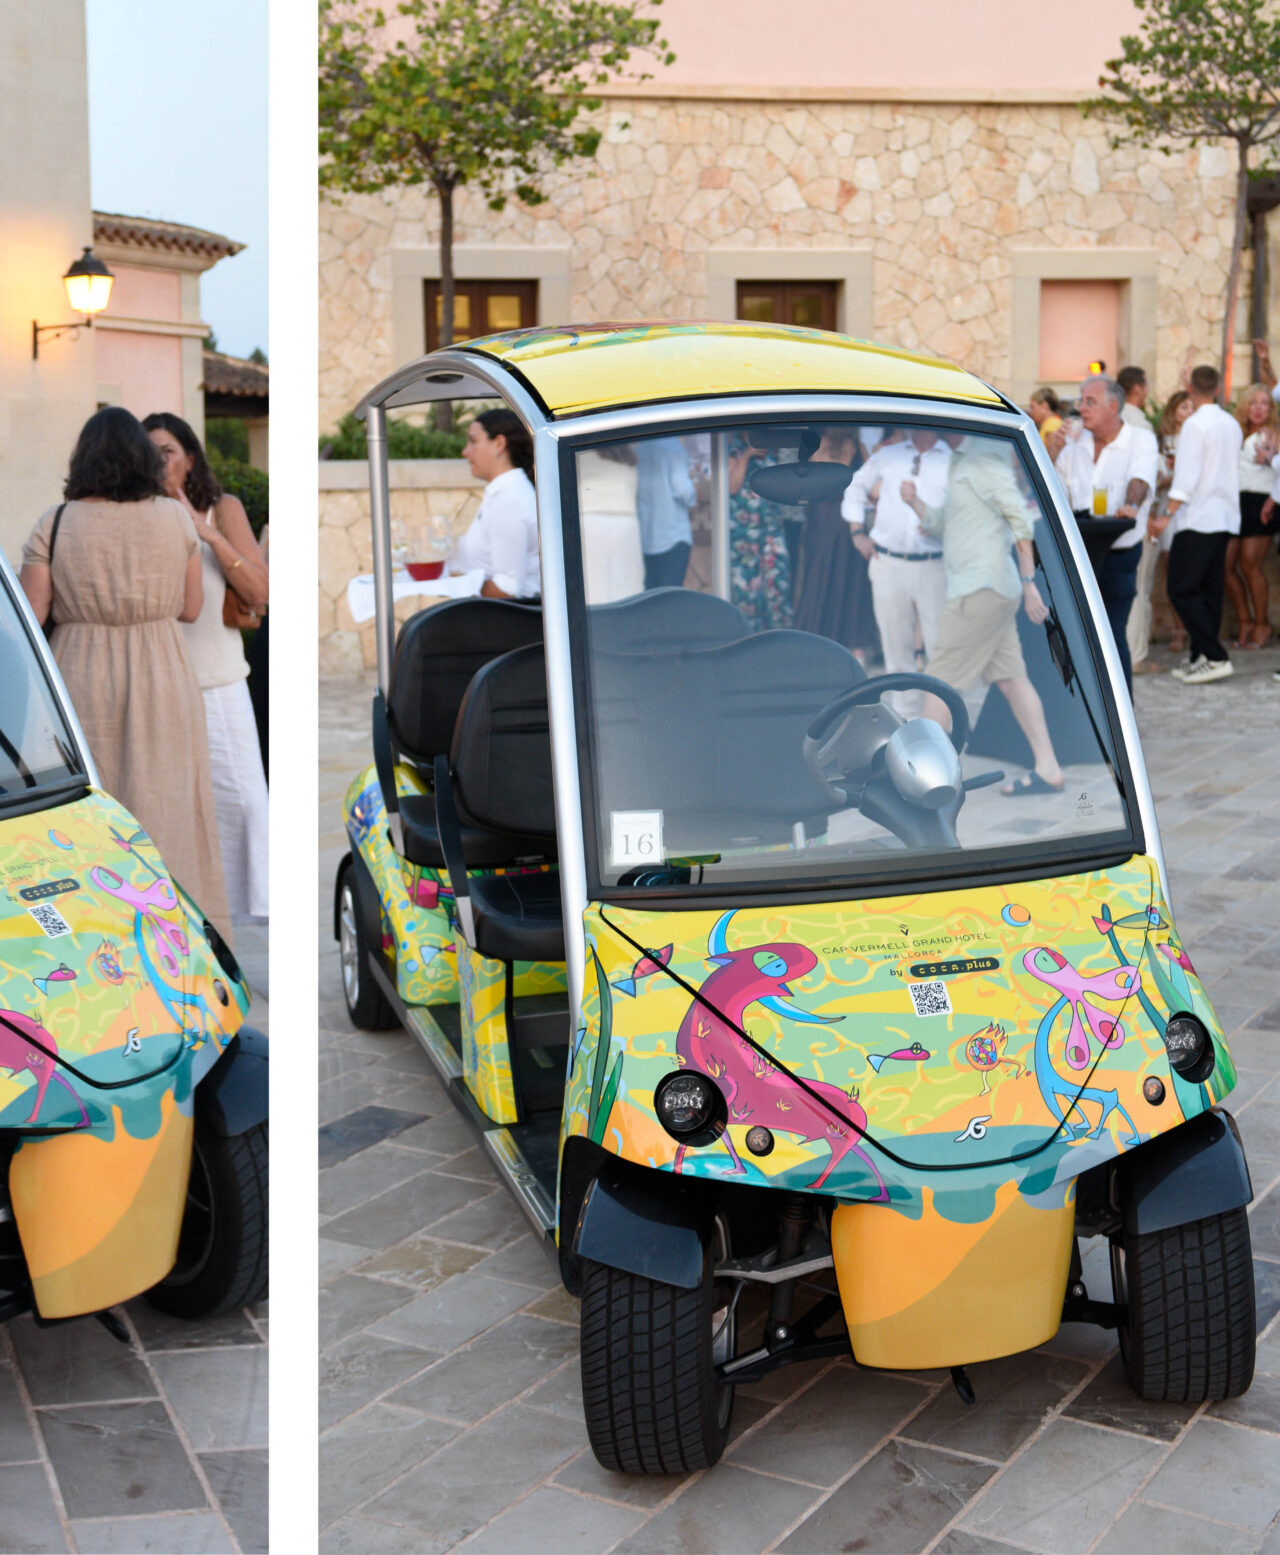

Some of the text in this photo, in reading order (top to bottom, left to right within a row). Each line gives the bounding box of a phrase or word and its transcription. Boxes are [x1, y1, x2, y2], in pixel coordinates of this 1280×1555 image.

[623, 832, 654, 855] 16
[850, 942, 909, 952] VERMELL
[912, 936, 952, 947] GRAND
[955, 932, 991, 942] HOTEL
[884, 949, 942, 960] MALLORCA
[890, 968, 903, 977] by
